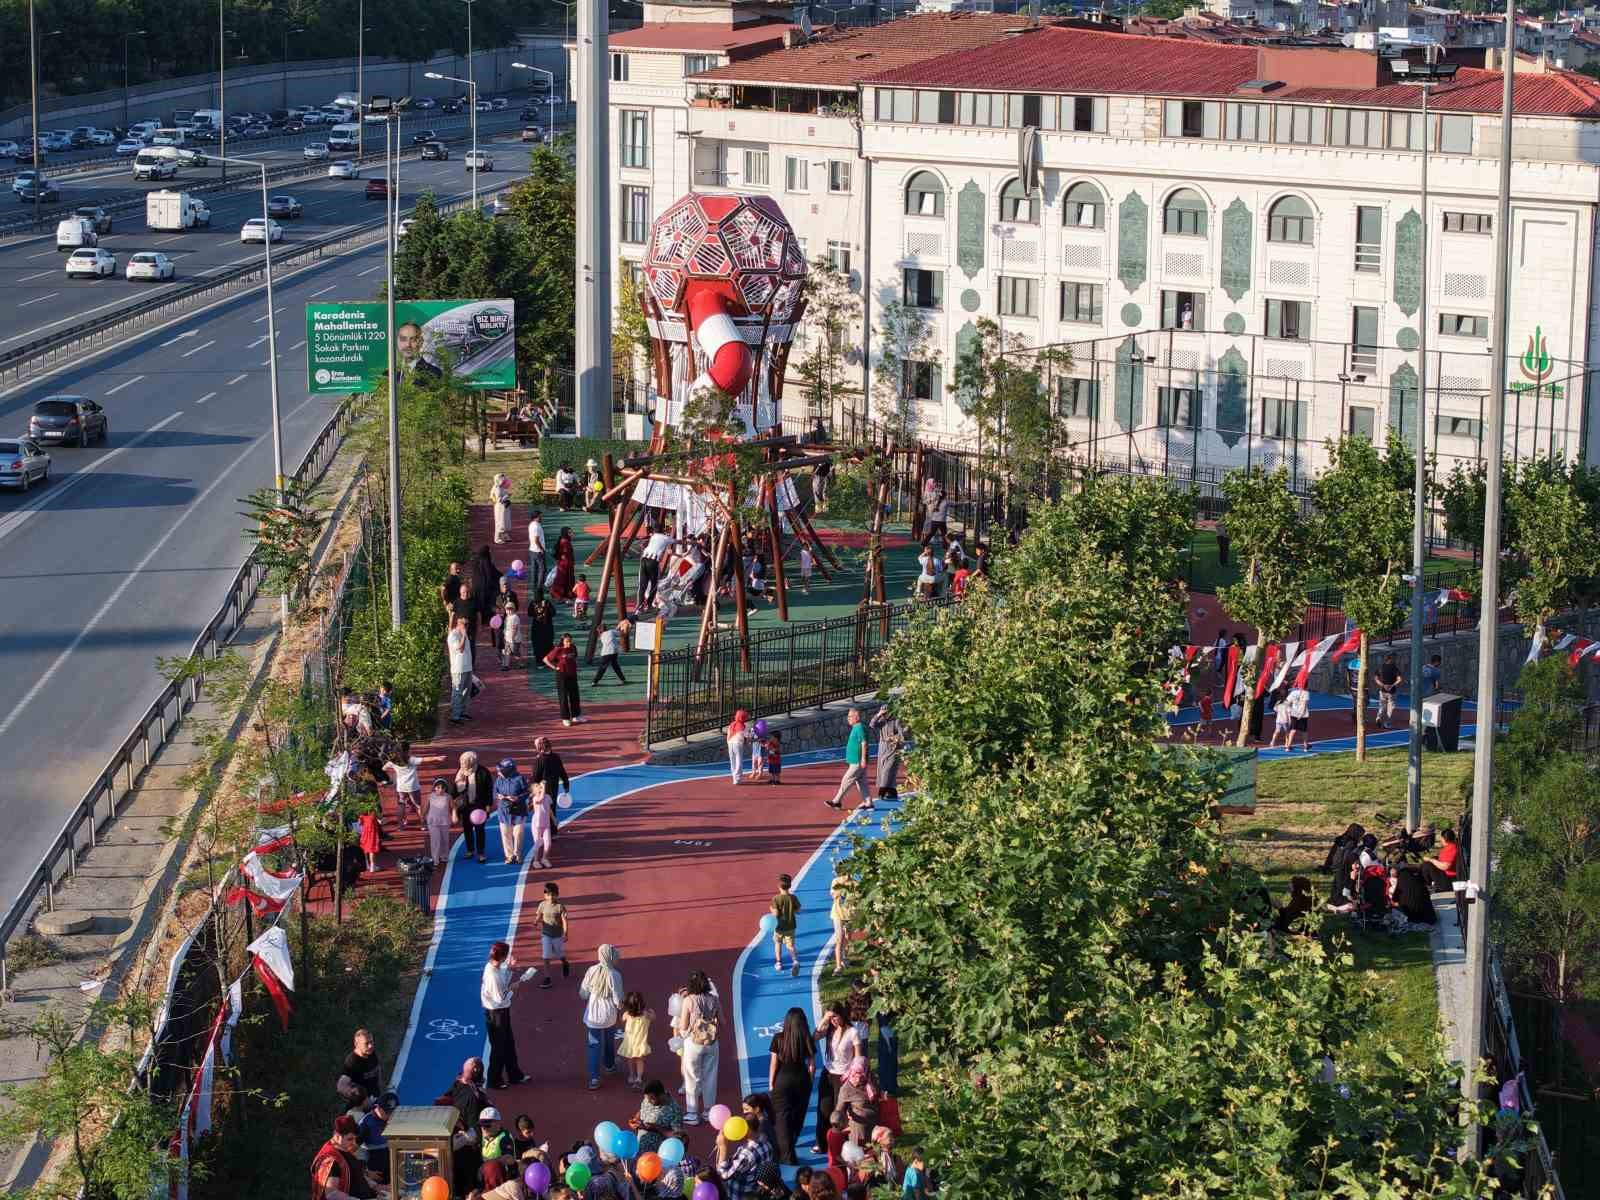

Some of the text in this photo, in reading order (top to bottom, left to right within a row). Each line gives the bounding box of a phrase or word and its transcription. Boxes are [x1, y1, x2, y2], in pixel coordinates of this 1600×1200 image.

[314, 310, 366, 320] Karadeniz
[314, 321, 378, 330] Mahallemize
[315, 333, 321, 341] 5
[315, 344, 339, 352] Sokak
